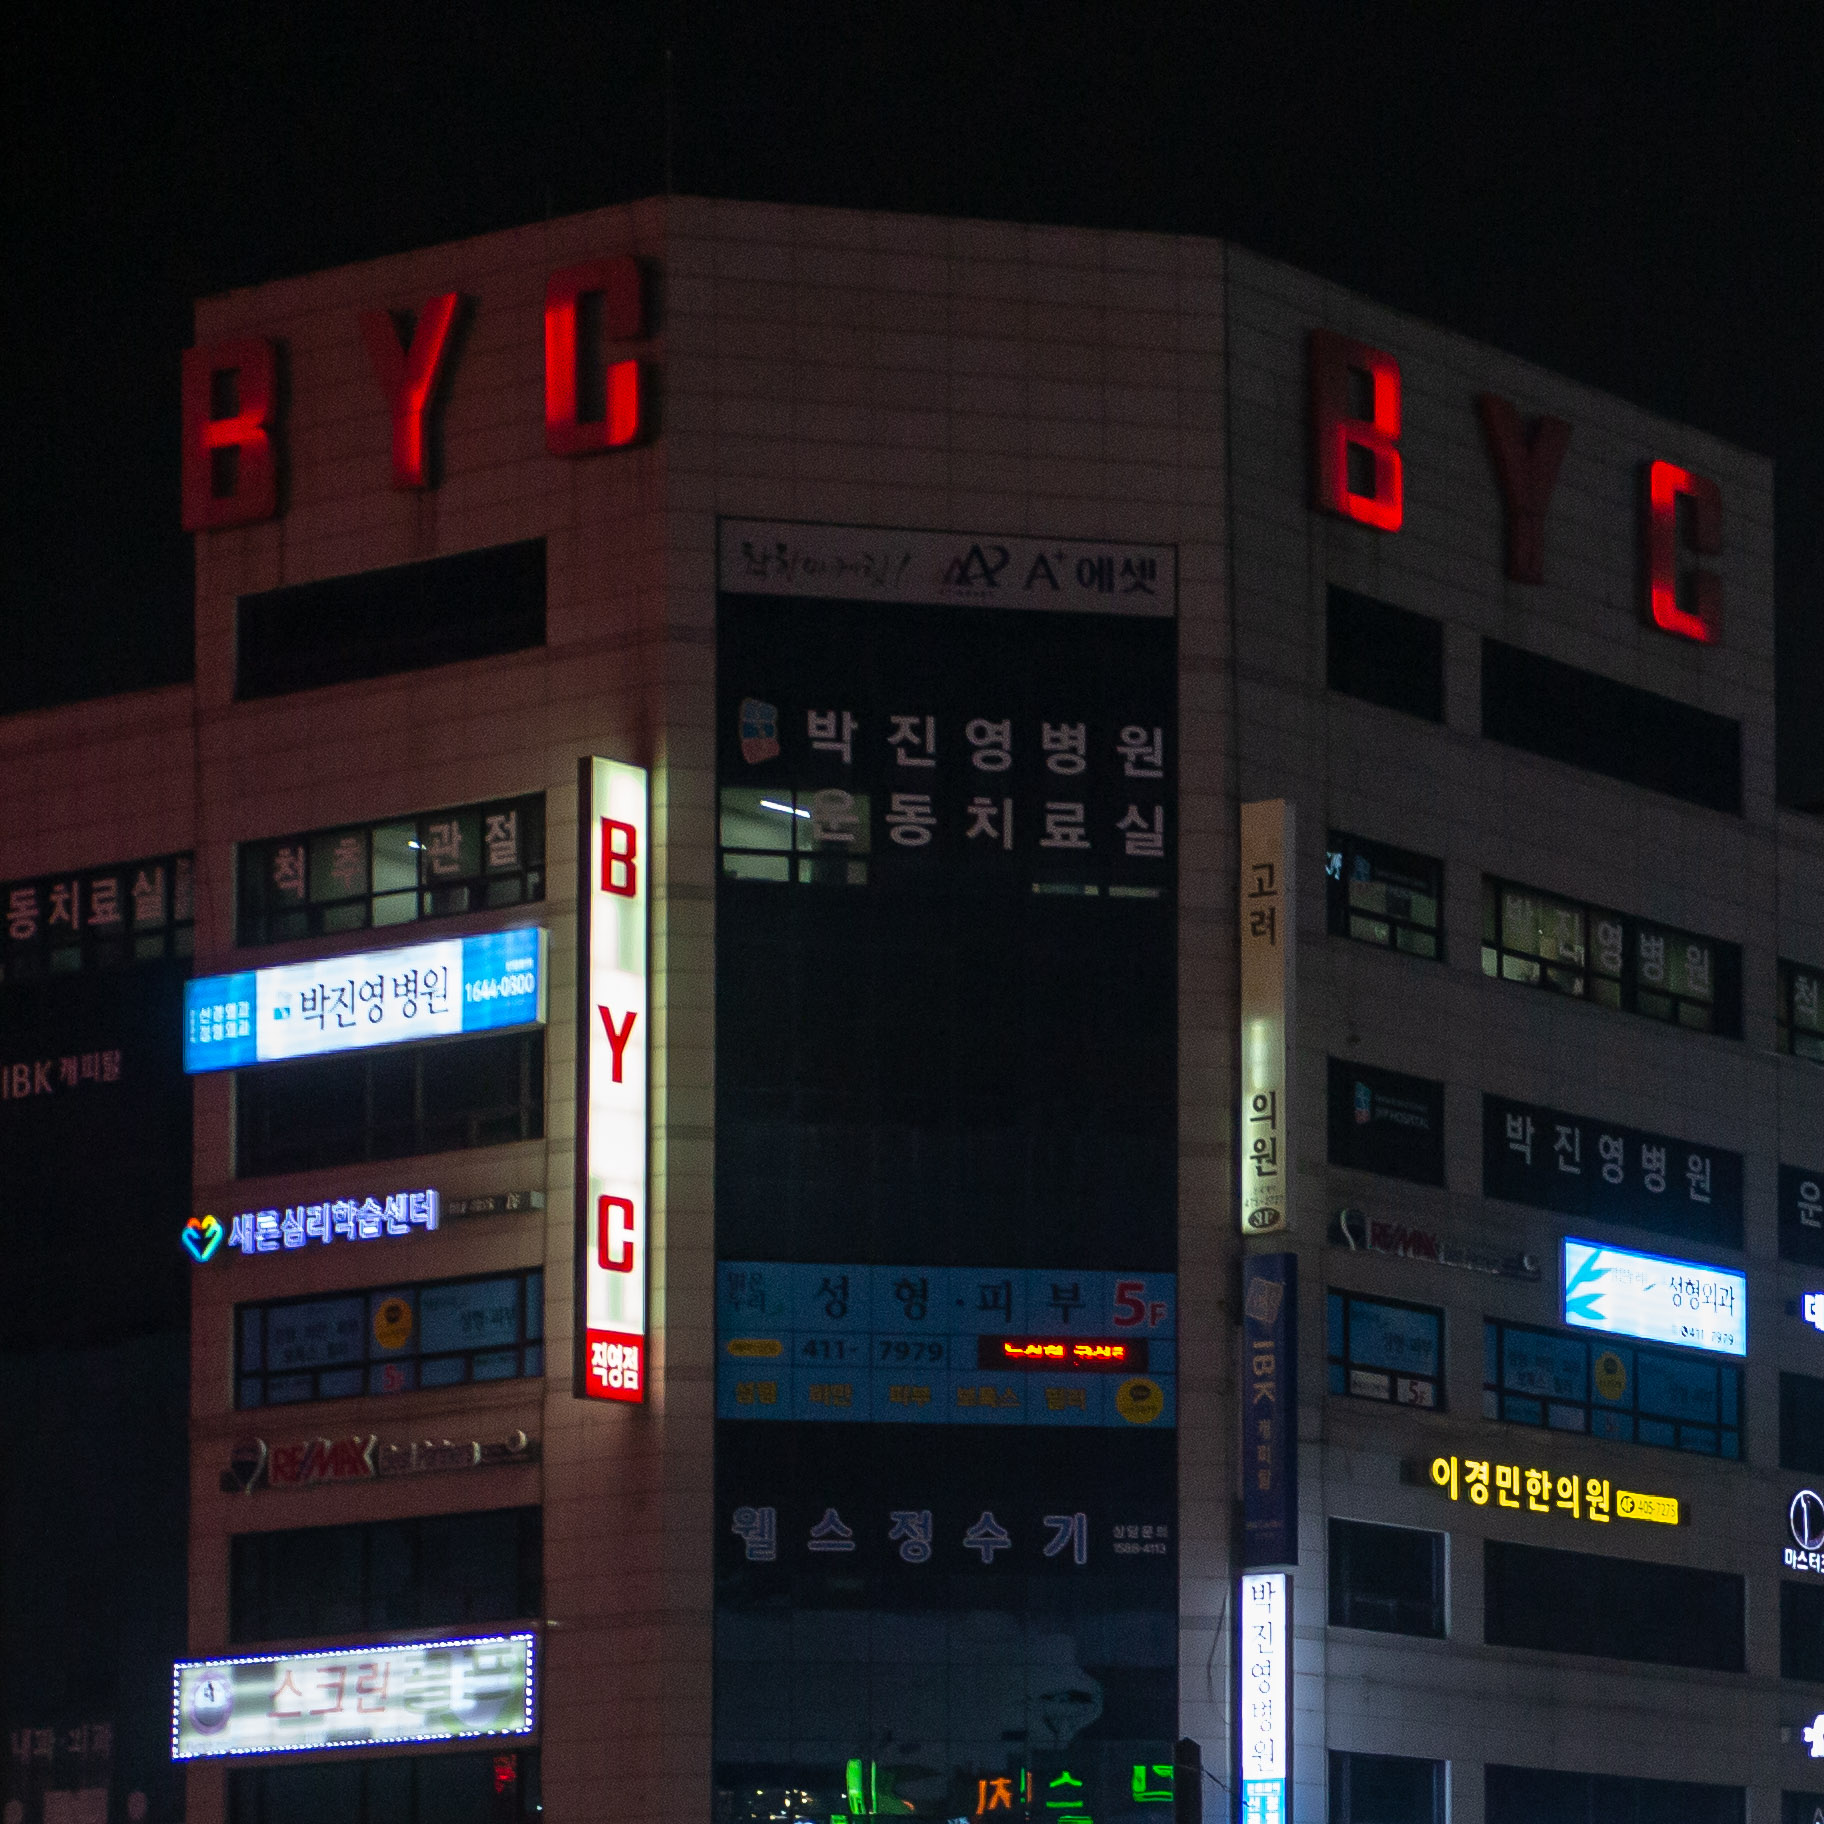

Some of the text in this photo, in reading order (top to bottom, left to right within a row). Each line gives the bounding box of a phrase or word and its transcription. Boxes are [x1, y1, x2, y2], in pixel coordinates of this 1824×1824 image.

[181, 258, 646, 532] BYC
[1311, 328, 1723, 645] BYC
[806, 708, 1165, 779] 박진영병원
[814, 788, 1164, 859] 운동치료실
[597, 816, 637, 1271] BYC
[1669, 1276, 1735, 1316] 성형외과
[590, 1346, 640, 1390] 직영점
[1432, 1456, 1610, 1523] 이경민한의원
[731, 1505, 1089, 1565] 웰스정수기
